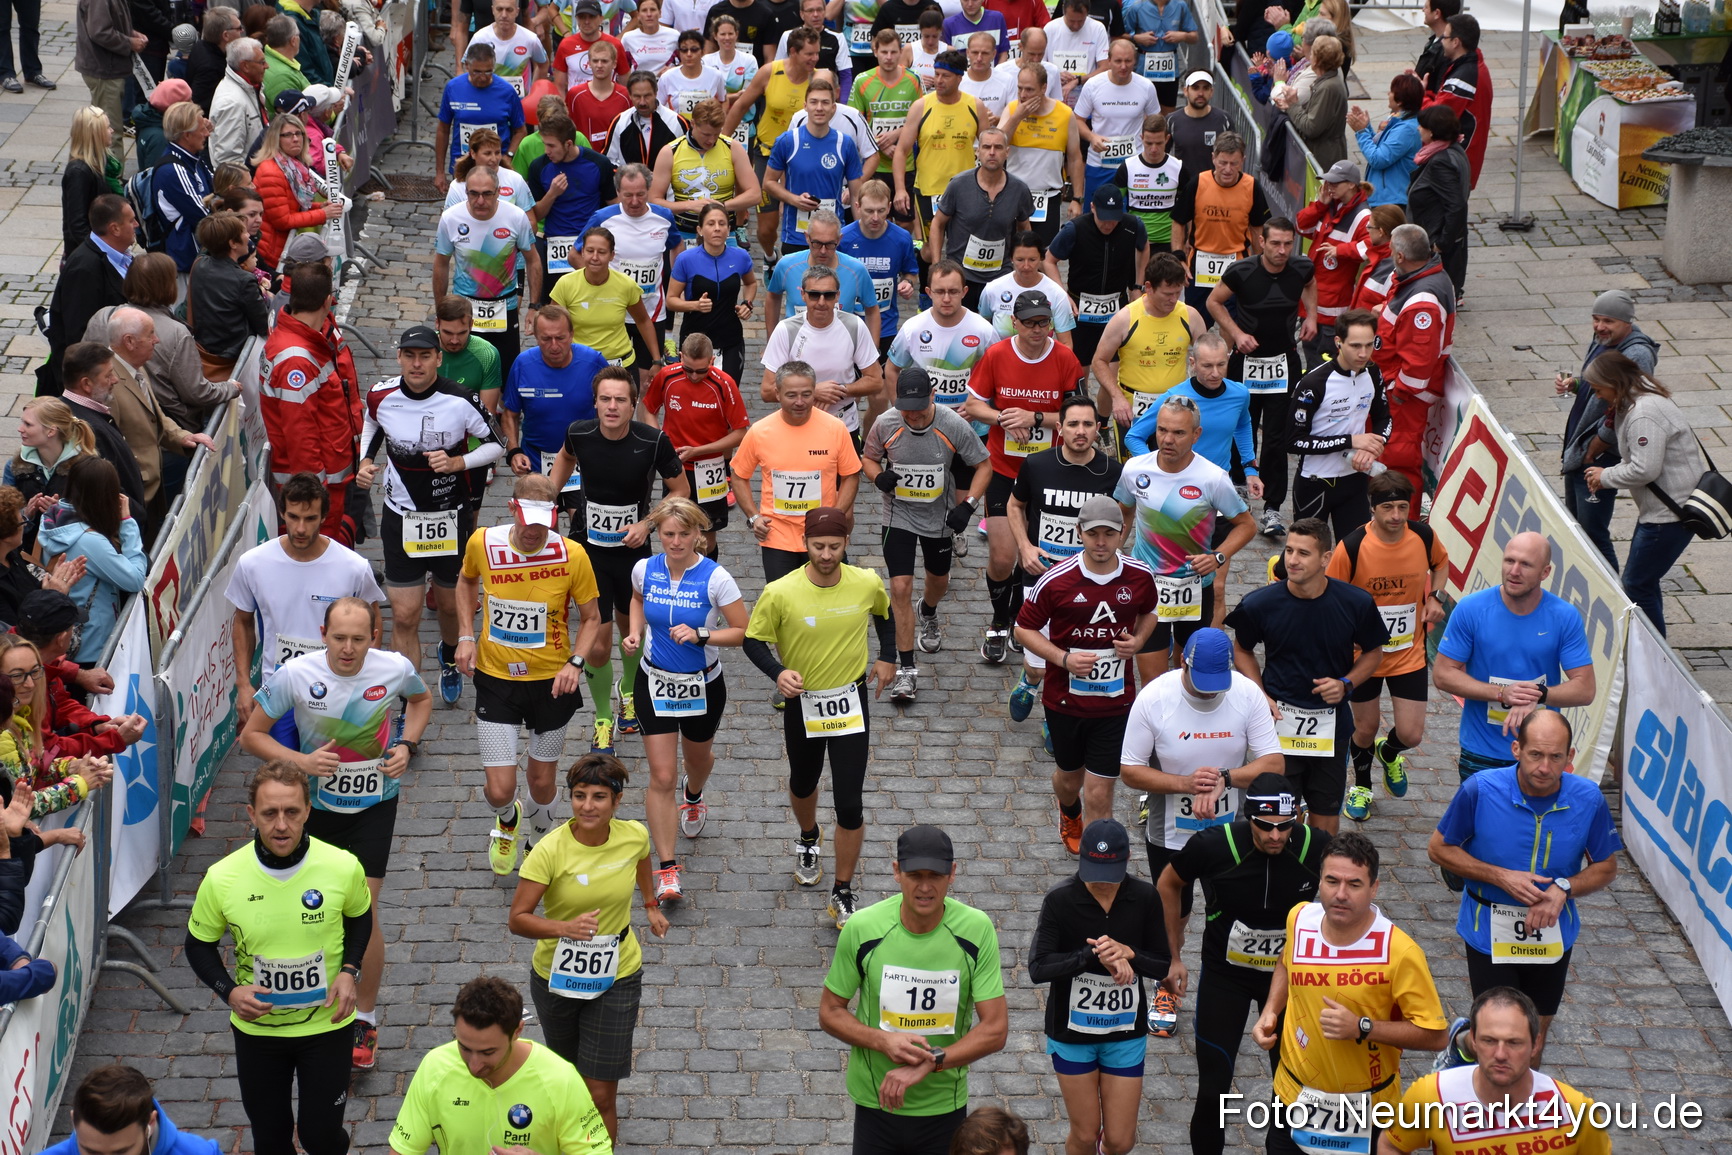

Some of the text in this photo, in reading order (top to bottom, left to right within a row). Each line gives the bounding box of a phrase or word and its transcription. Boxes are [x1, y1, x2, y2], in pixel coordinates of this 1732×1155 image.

[339, 35, 356, 73] Laufsport
[1063, 59, 1077, 71] 44
[1147, 59, 1173, 71] 2190
[1104, 142, 1133, 157] 2508
[327, 159, 338, 183] BMW
[977, 248, 994, 260] 90
[1208, 261, 1224, 274] 97
[477, 306, 495, 318] 56
[1083, 299, 1117, 315] 2750
[1248, 364, 1284, 380] 2116
[930, 377, 967, 393] 2493
[1251, 381, 1281, 389] Alexander
[1000, 386, 1051, 399] NEUMARKT
[691, 400, 717, 409] Marcel
[1312, 437, 1347, 449] Trizone
[904, 474, 935, 489] 278
[785, 482, 807, 499] 77
[909, 490, 931, 498] Stefan
[784, 502, 808, 510] Oswald
[1041, 516, 1058, 524] PARTL
[415, 521, 448, 539] 156
[416, 542, 445, 551] Michael
[1048, 545, 1077, 555] Joachim
[491, 567, 570, 585] MAX BÖGL
[1372, 579, 1407, 591] OEXL
[650, 584, 699, 599] Radsport
[1117, 592, 1131, 600] FCN
[1160, 588, 1193, 604] 510
[489, 600, 537, 612] PARTL Neumarkt
[646, 592, 703, 609] Neumüller
[1158, 606, 1192, 616] JOSEF
[493, 610, 539, 631] 2731
[502, 633, 529, 643] Jürgen
[1071, 626, 1130, 638] AREVA
[278, 638, 327, 650] PARTL Neumarkt
[655, 679, 701, 699] 2820
[1088, 683, 1109, 692] Peter
[822, 690, 848, 699] Neumarkt
[308, 700, 328, 708] PARTL
[664, 701, 691, 711] Martina
[814, 696, 850, 718] 100
[1278, 705, 1297, 715] PARTL
[821, 720, 848, 730] Tobias
[1294, 717, 1318, 736] 72
[1193, 731, 1234, 739] KLEBL
[1291, 740, 1318, 749] Tobias
[344, 765, 375, 773] Neumarkt
[324, 773, 378, 794] 2696
[336, 797, 361, 807] David
[1628, 709, 1732, 906] slac
[1089, 851, 1117, 859] ORACLE
[301, 911, 325, 922] Partl
[1493, 908, 1516, 918] PARTL
[1513, 919, 1543, 942] 94
[560, 938, 610, 949] PARTL Neumarkt
[1242, 938, 1284, 955] 242
[1510, 944, 1547, 956] Christof
[254, 957, 313, 970] PARTL Neumarkt
[559, 948, 614, 975] 2567
[1248, 957, 1277, 966] Zoltan
[259, 966, 320, 992] 3066
[884, 972, 947, 984] PARTL Neumarkt
[1074, 977, 1098, 986] PARTL
[1291, 968, 1390, 987] MAX BÖGL
[565, 978, 602, 990] Cornelia
[906, 986, 936, 1011] 18
[1077, 986, 1134, 1011] 2480
[898, 1016, 937, 1027] Thomas
[1086, 1015, 1120, 1027] Viktoria
[504, 1130, 531, 1142] Partl
[1310, 1135, 1351, 1149] Dietmar
